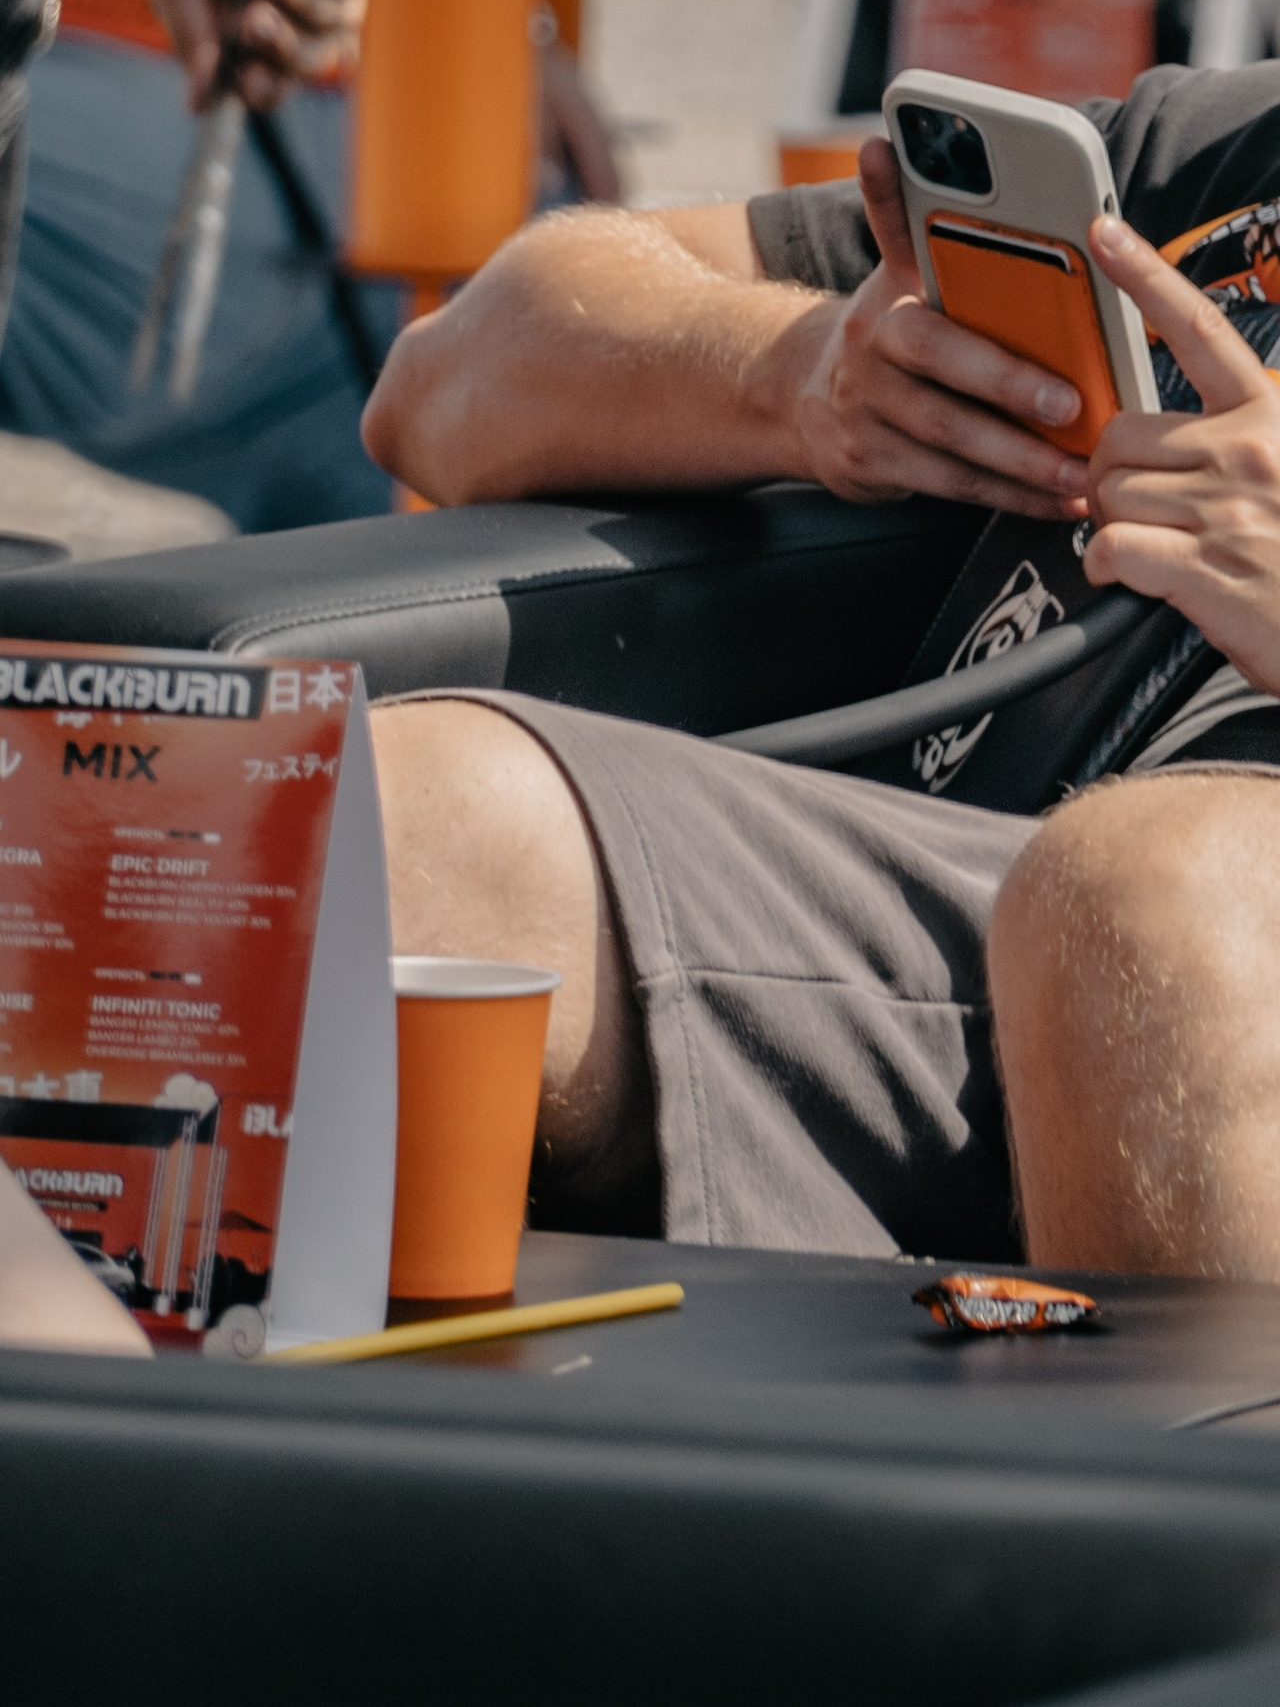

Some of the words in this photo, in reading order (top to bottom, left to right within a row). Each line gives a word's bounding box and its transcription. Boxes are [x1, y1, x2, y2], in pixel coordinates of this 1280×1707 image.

[0, 660, 249, 716] BLACKBURN
[269, 665, 346, 712] 日本
[63, 741, 160, 781] MIX
[111, 854, 152, 873] EPIC
[157, 857, 210, 876] DRIFT
[92, 995, 162, 1015] INFINITI
[168, 1000, 221, 1020] TONIC
